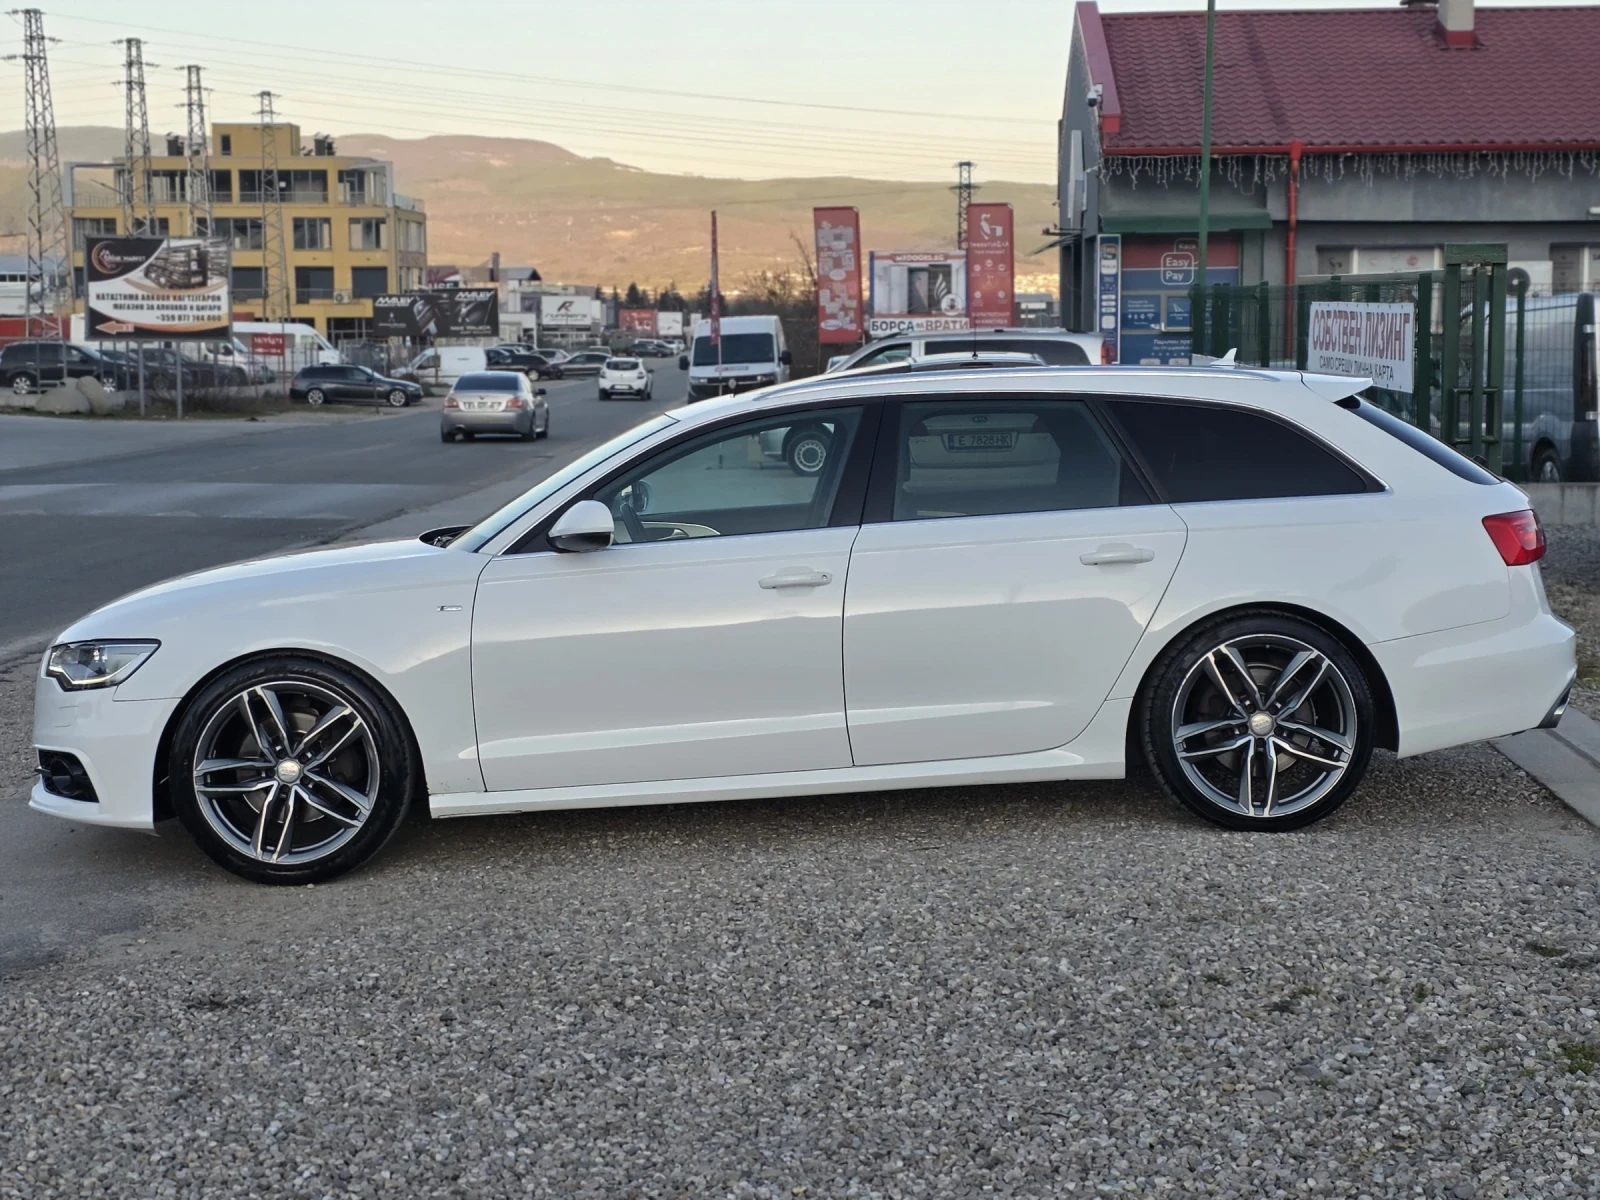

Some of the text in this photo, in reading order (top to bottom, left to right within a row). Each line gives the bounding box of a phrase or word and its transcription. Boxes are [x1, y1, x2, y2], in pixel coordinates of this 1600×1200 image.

[1165, 257, 1190, 268] Easy
[1165, 270, 1185, 281] Pay
[871, 320, 915, 332] БОРСА
[926, 320, 969, 331] ВРАТИ
[1312, 309, 1410, 362] СОБСТВЕН ЛИЗИНГ
[1320, 355, 1394, 382] САМО СРЕЩУ ЛИЧНА КАРТА
